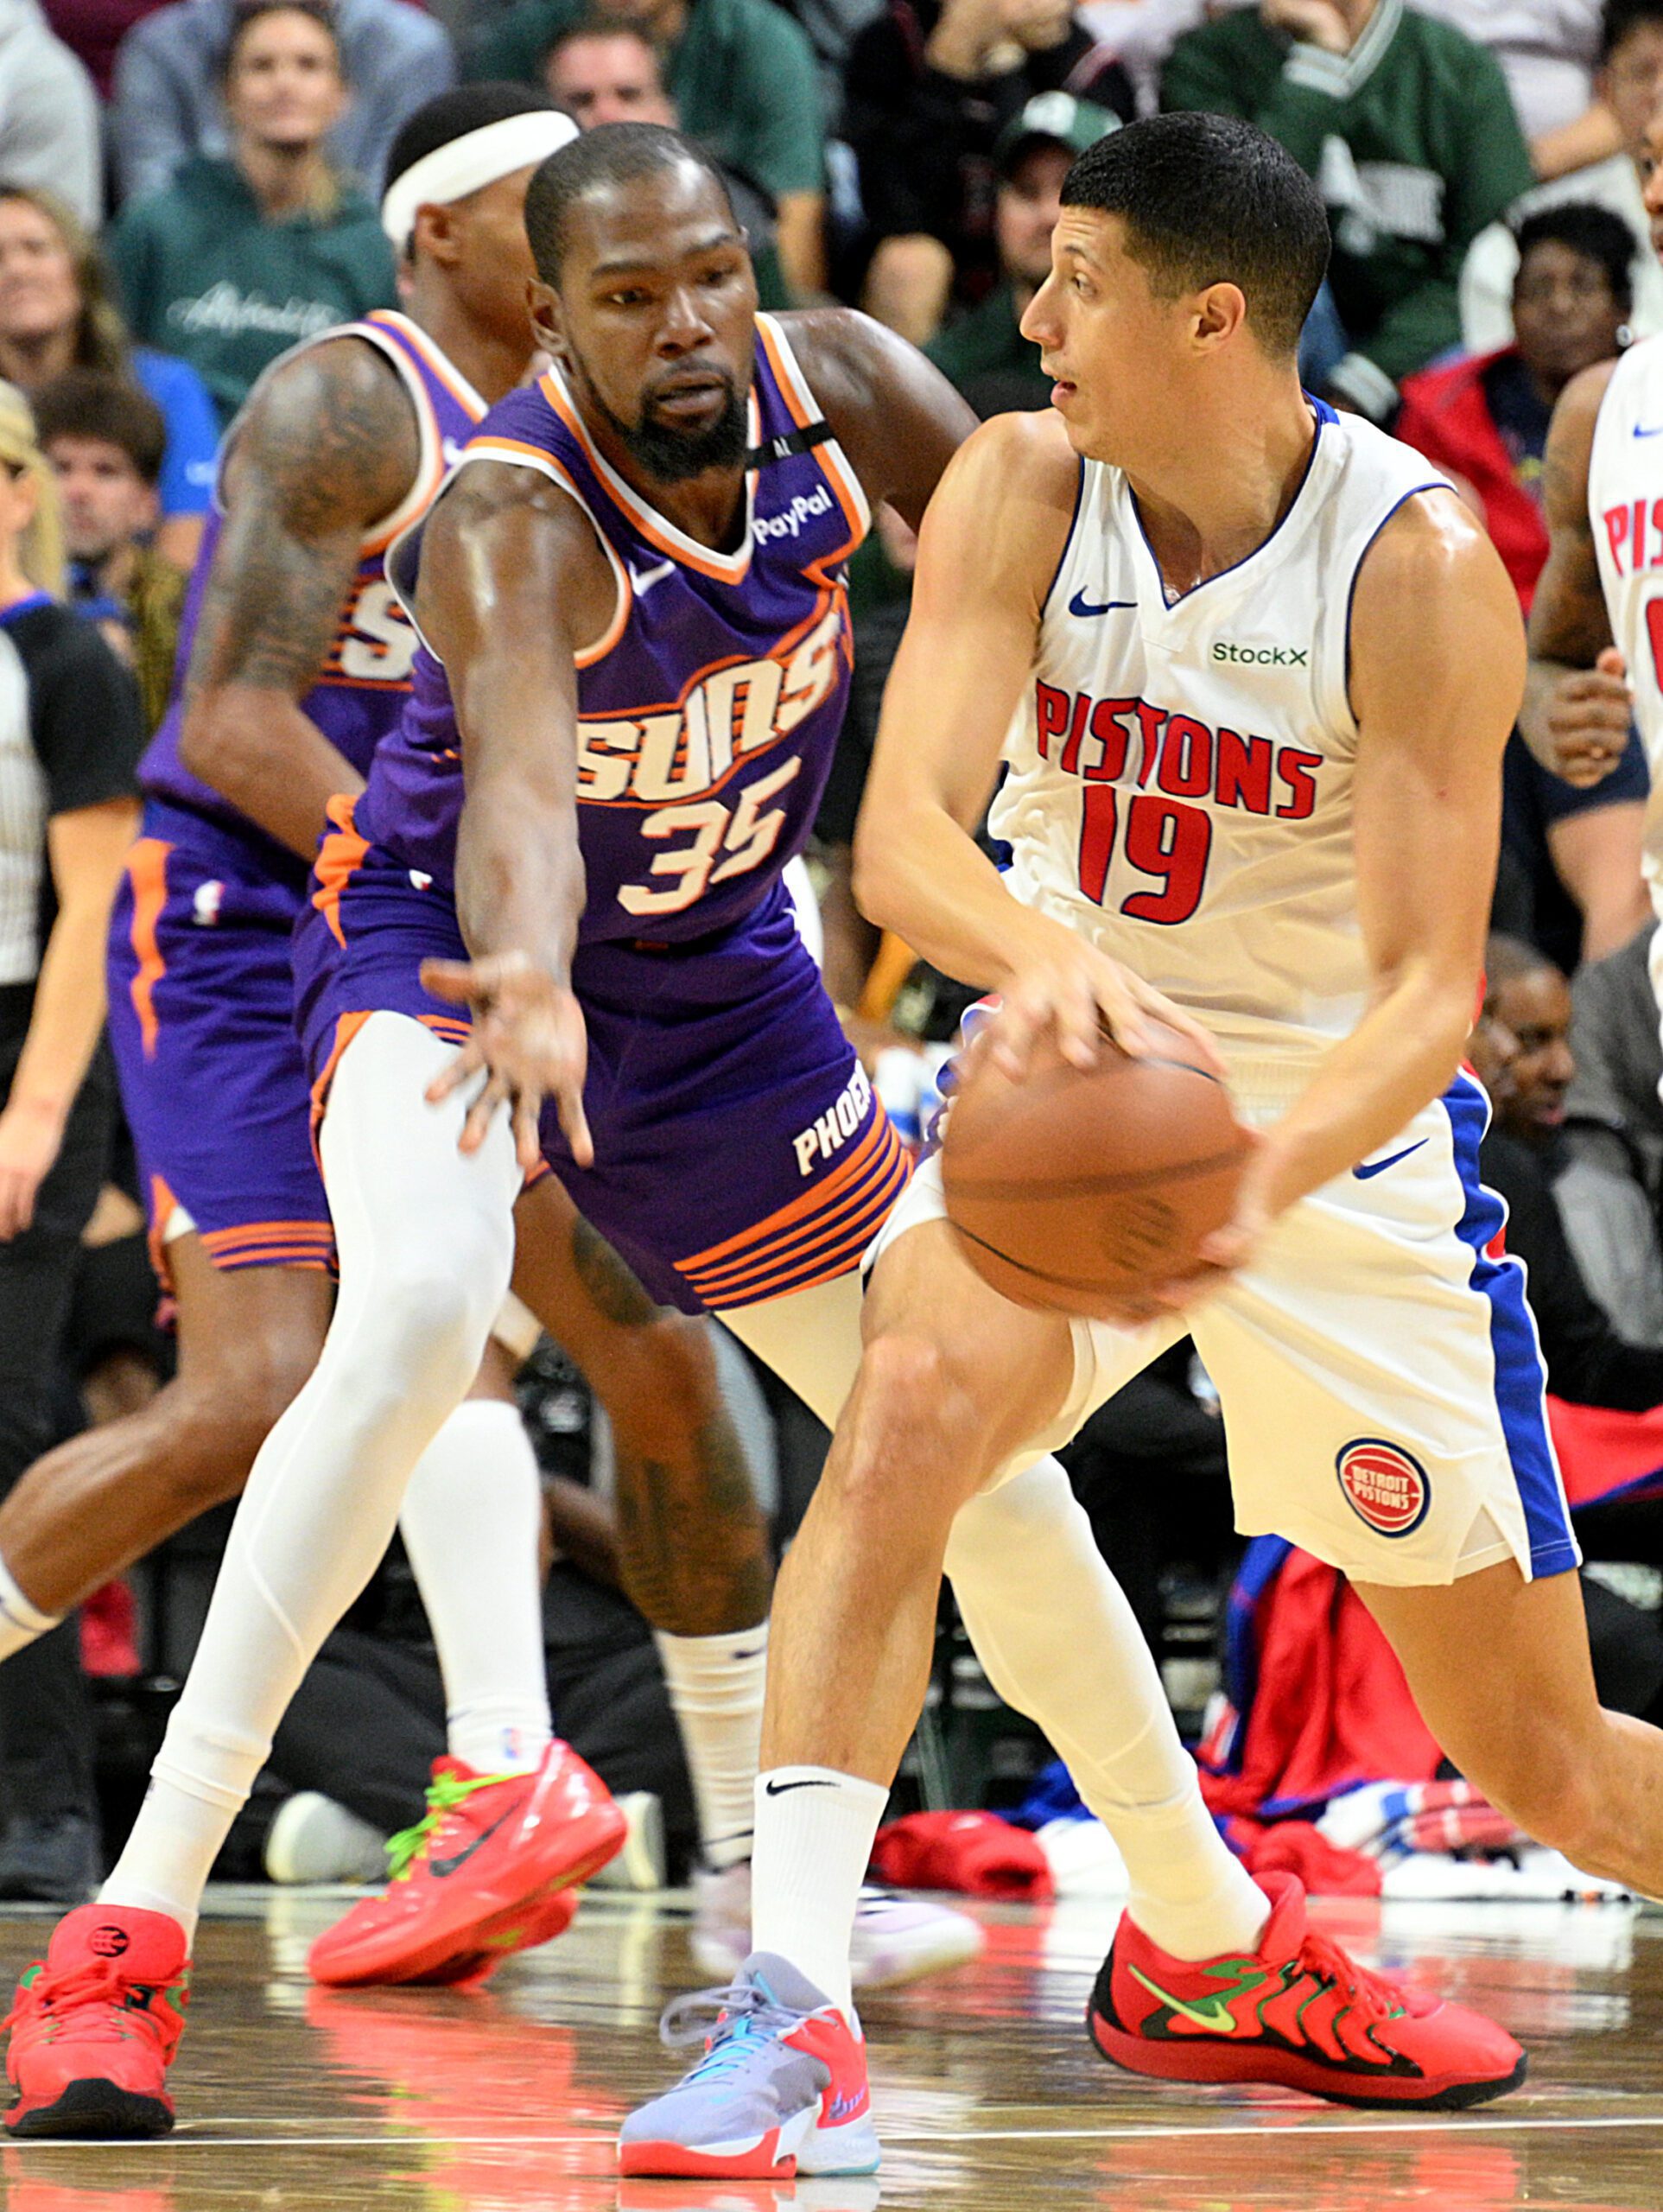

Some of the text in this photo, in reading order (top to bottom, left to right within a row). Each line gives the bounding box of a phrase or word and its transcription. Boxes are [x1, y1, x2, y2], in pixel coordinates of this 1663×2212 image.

[751, 484, 834, 546] PayPal
[1212, 642, 1308, 667] StockX
[575, 610, 841, 802] SUNS
[1035, 677, 1324, 820] PISTONS
[616, 754, 803, 916] 35
[1078, 783, 1213, 925] 19
[1351, 1465, 1410, 1494] DETROIT
[1352, 1479, 1410, 1510] PISTONS
